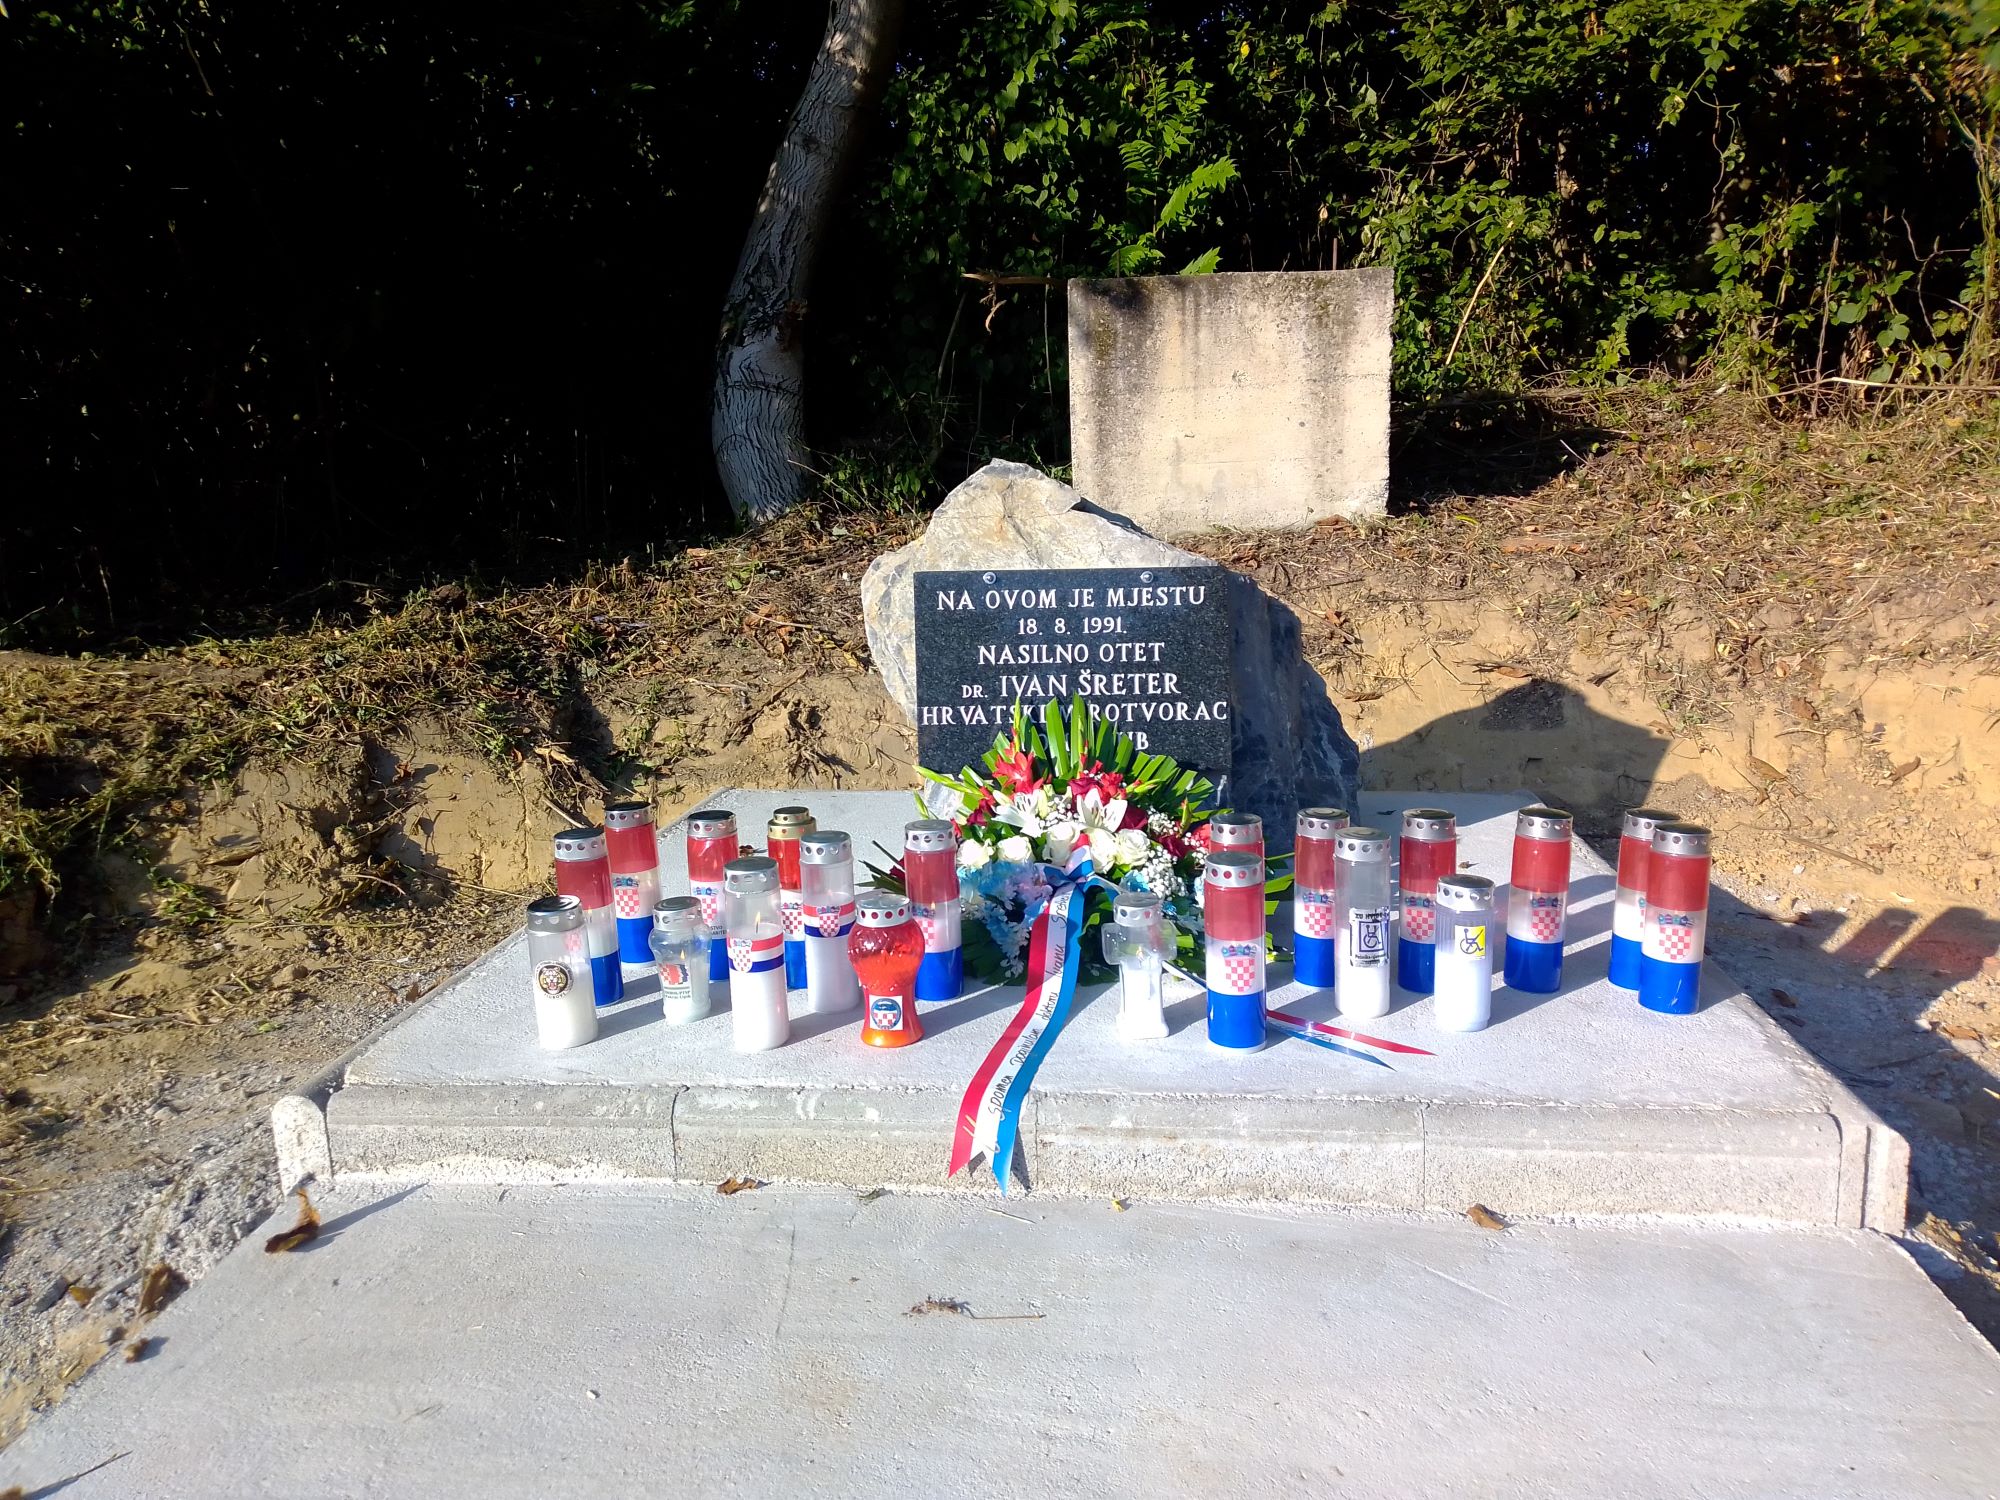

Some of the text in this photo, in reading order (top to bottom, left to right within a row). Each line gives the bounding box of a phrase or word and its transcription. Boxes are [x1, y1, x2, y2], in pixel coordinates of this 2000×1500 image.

[936, 586, 1205, 610] NA OVOM JE MJESTU
[1018, 616, 1127, 635] 18. 8. 1991.
[977, 642, 1165, 665] NASILNO OTET
[962, 669, 1181, 698] DR. IVAN ŠRETER
